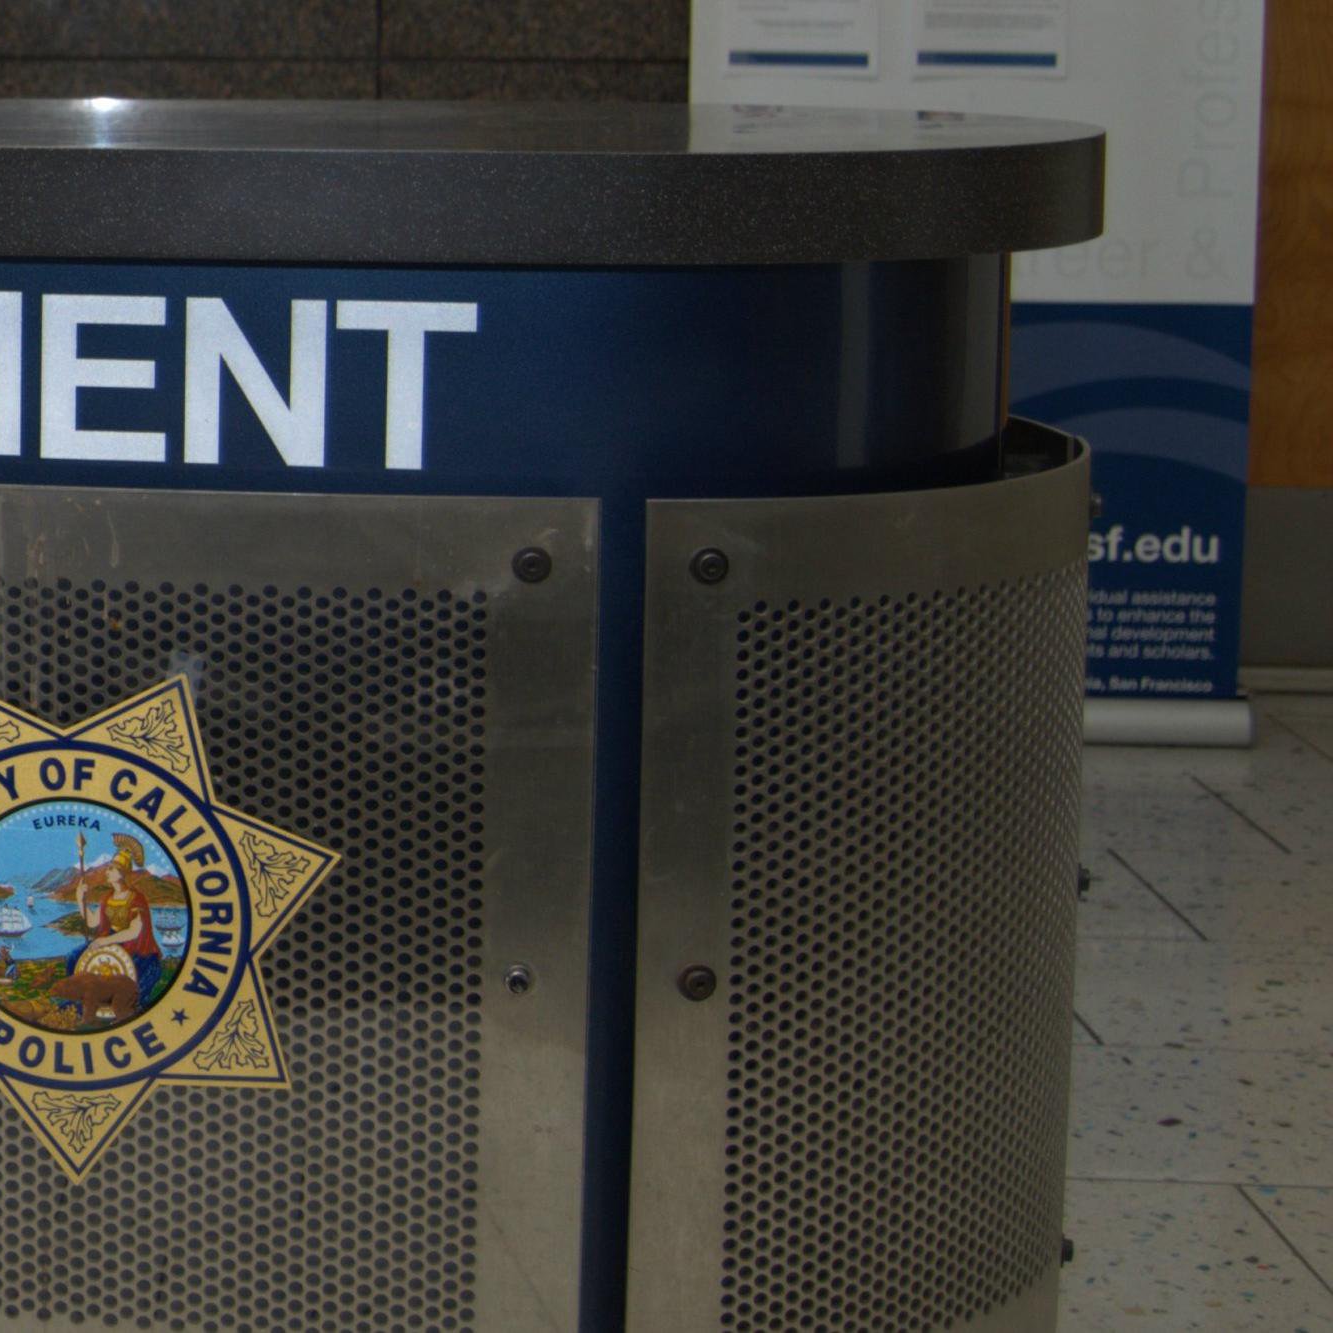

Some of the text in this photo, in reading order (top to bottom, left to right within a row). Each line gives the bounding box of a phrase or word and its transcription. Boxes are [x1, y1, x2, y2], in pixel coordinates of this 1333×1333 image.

[1131, 590, 1217, 606] assistance
[1097, 608, 1115, 624] to
[1116, 608, 1186, 624] enhance
[1189, 608, 1217, 624] the
[1110, 626, 1215, 643] development
[1108, 642, 1139, 659] and
[1142, 643, 1215, 661] scholars.
[1109, 675, 1139, 691] San
[1140, 676, 1213, 693] Francisco
[32, 814, 102, 832] EUREKA
[39, 757, 96, 791] OF
[109, 768, 234, 999] CALIFORNIA
